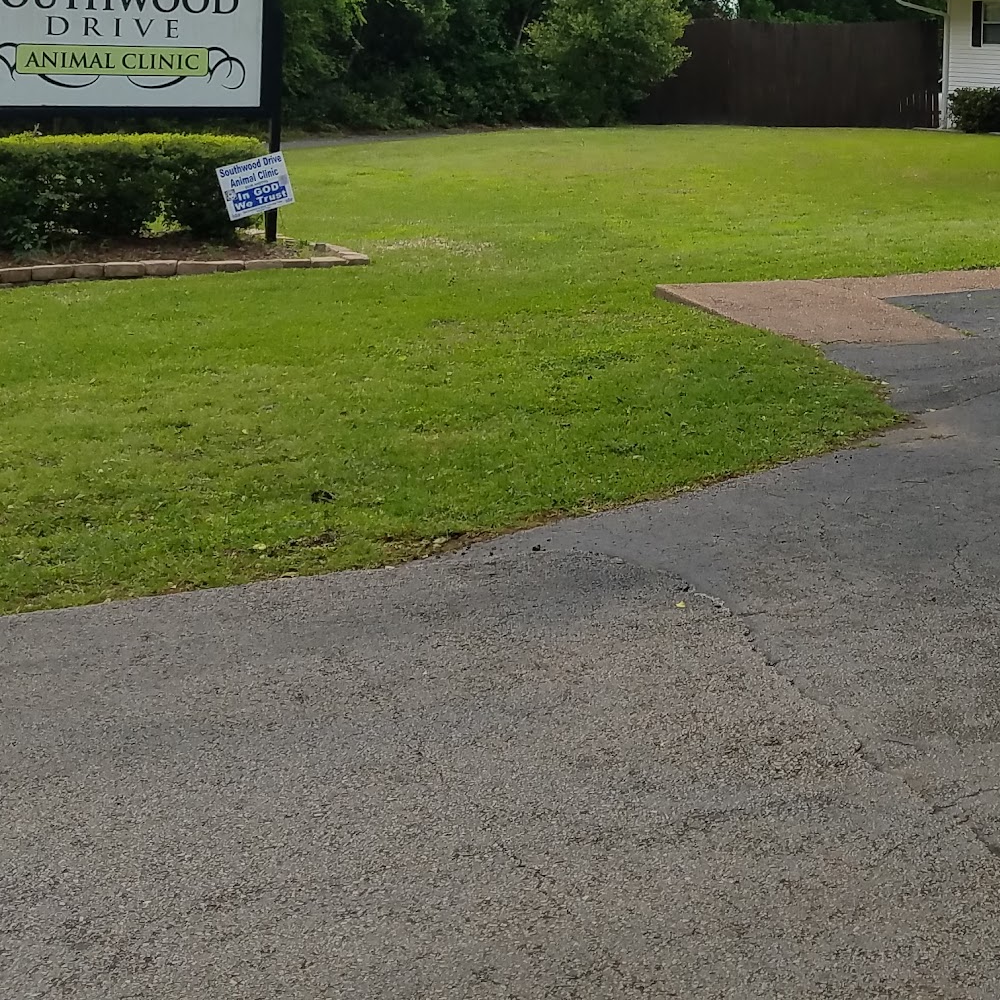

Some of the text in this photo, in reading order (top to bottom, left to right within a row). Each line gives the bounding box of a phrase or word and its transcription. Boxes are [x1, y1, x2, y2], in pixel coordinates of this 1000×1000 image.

[47, 15, 179, 38] DRIVE
[24, 51, 199, 70] ANIMAL CLINIC
[220, 155, 282, 178] Southwood Drive
[230, 173, 257, 188] Animal
[257, 168, 279, 179] Clinic
[235, 201, 253, 211] We
[256, 190, 287, 204] Trust
[238, 192, 250, 201] In
[253, 183, 279, 196] GOD
